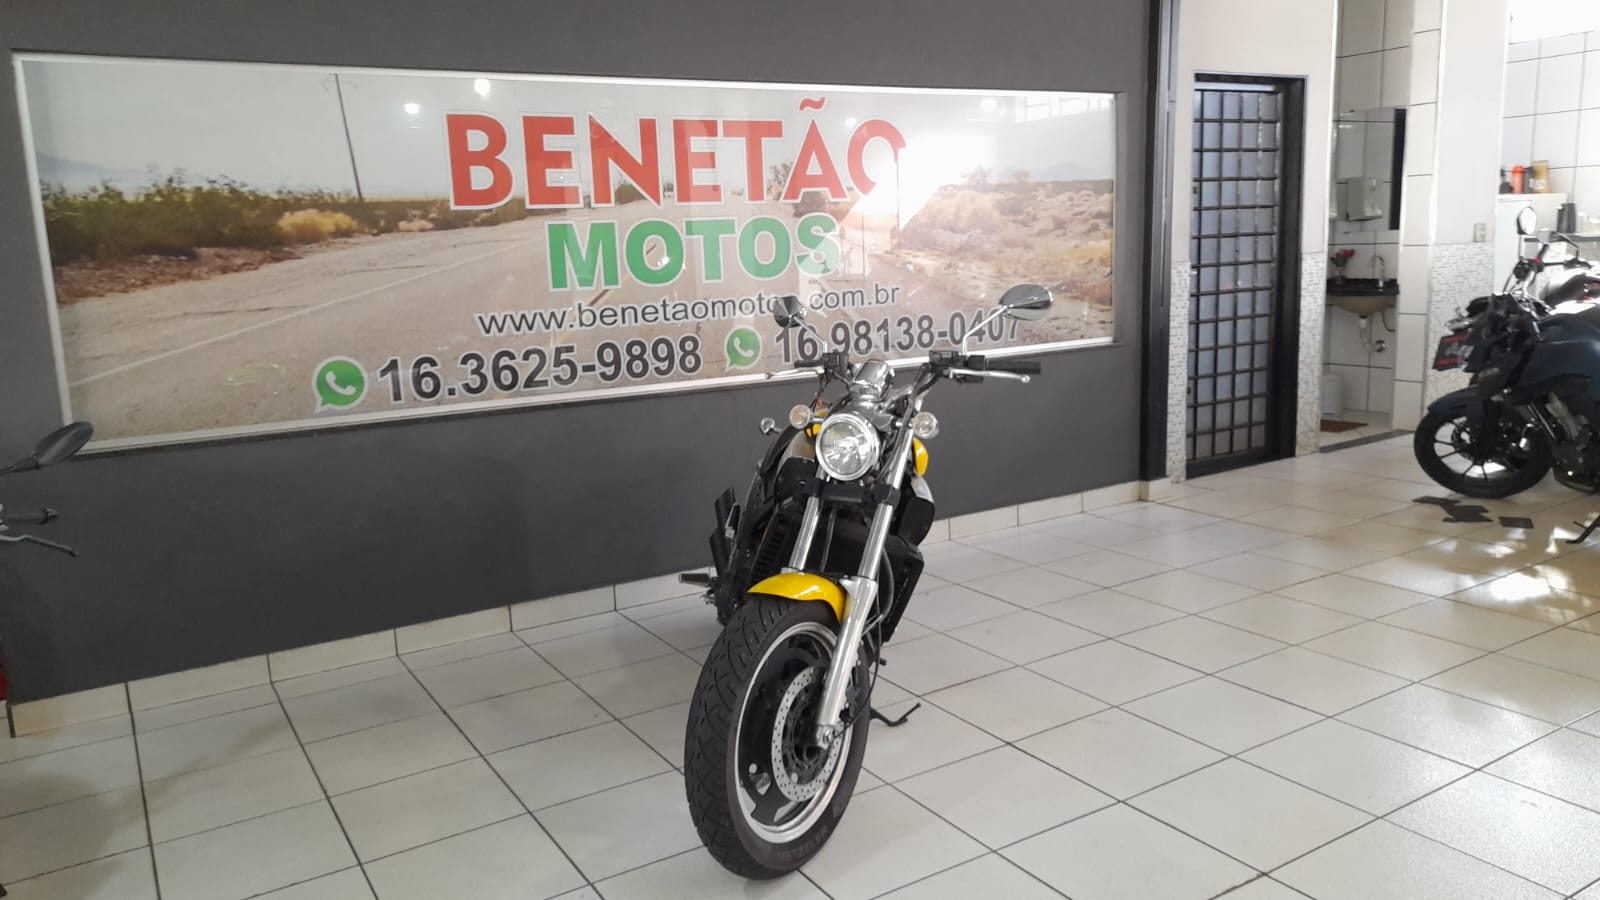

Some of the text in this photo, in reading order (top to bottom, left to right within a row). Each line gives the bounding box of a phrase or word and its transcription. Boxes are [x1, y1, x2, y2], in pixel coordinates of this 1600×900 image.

[446, 97, 906, 207] BENETÃO
[547, 214, 840, 289] MOTOS
[478, 283, 899, 335] www.benetaomotocom.br
[776, 307, 1019, 362] 1698138-0407
[378, 335, 702, 402] 16.3625-9898
